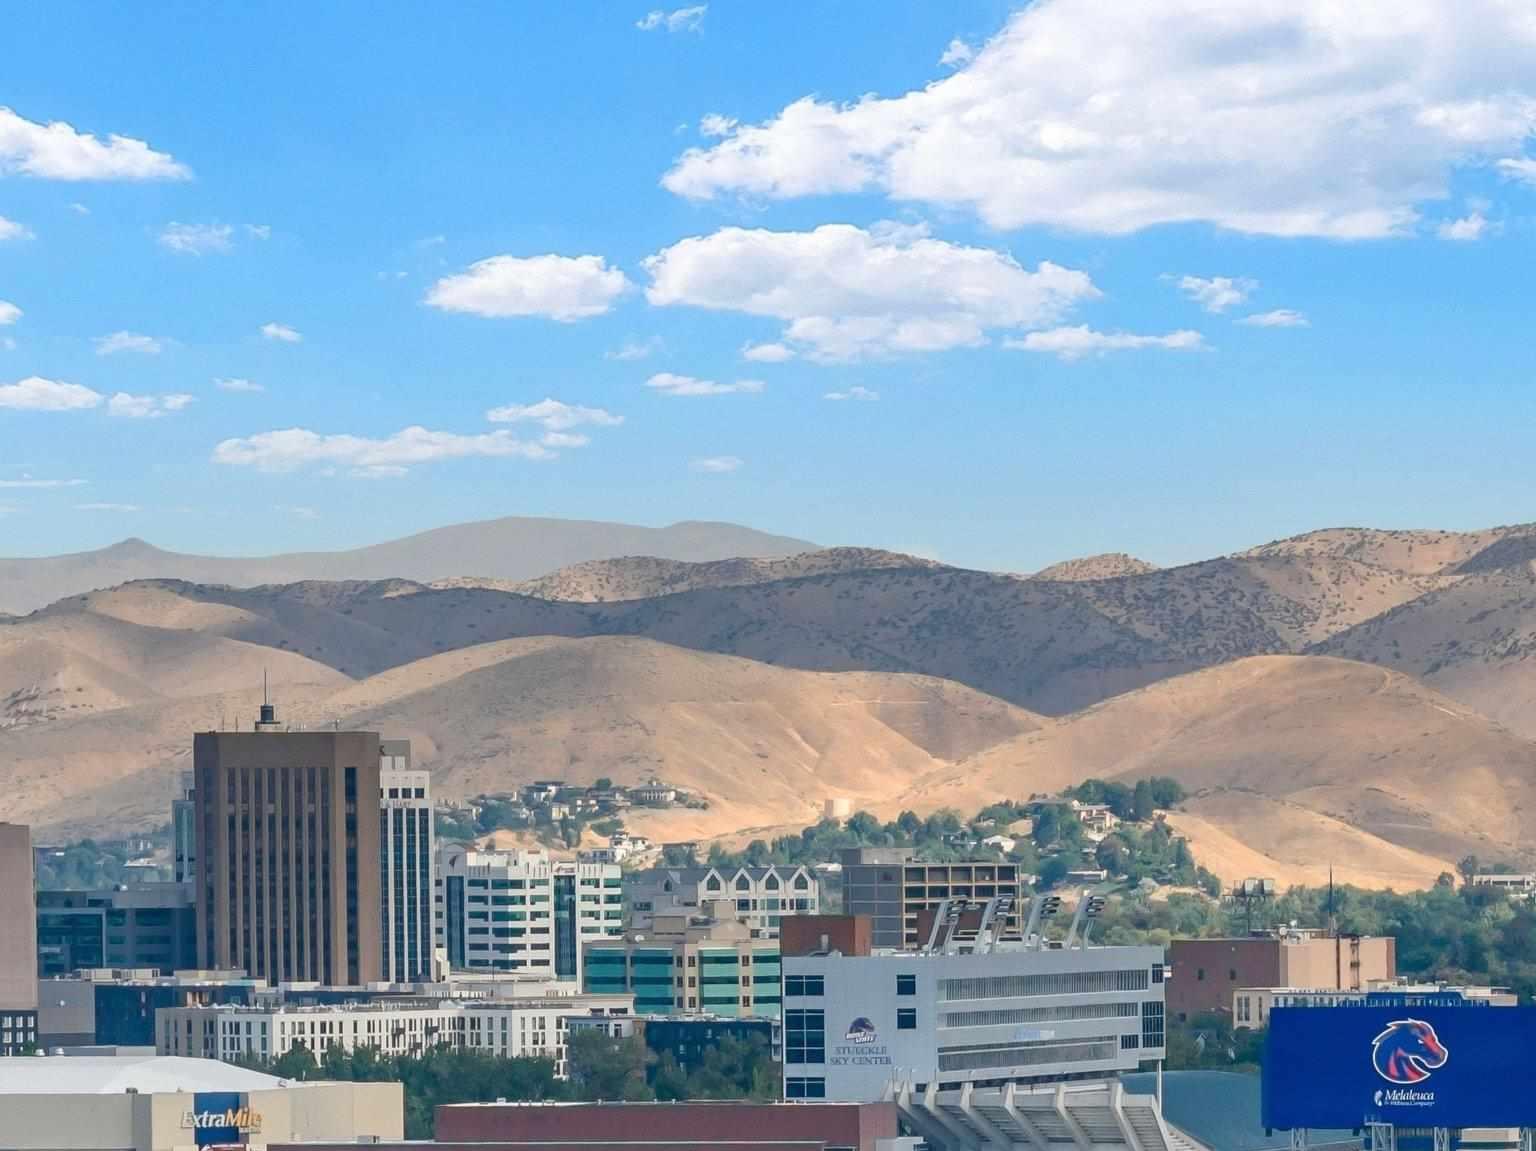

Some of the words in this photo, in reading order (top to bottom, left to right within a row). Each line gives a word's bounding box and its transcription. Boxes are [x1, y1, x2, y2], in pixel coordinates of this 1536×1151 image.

[830, 1057, 848, 1065] SKY
[852, 1056, 892, 1065] CENTER
[1384, 1089, 1434, 1101] Melaleuca
[181, 1109, 263, 1129] ExtraMile
